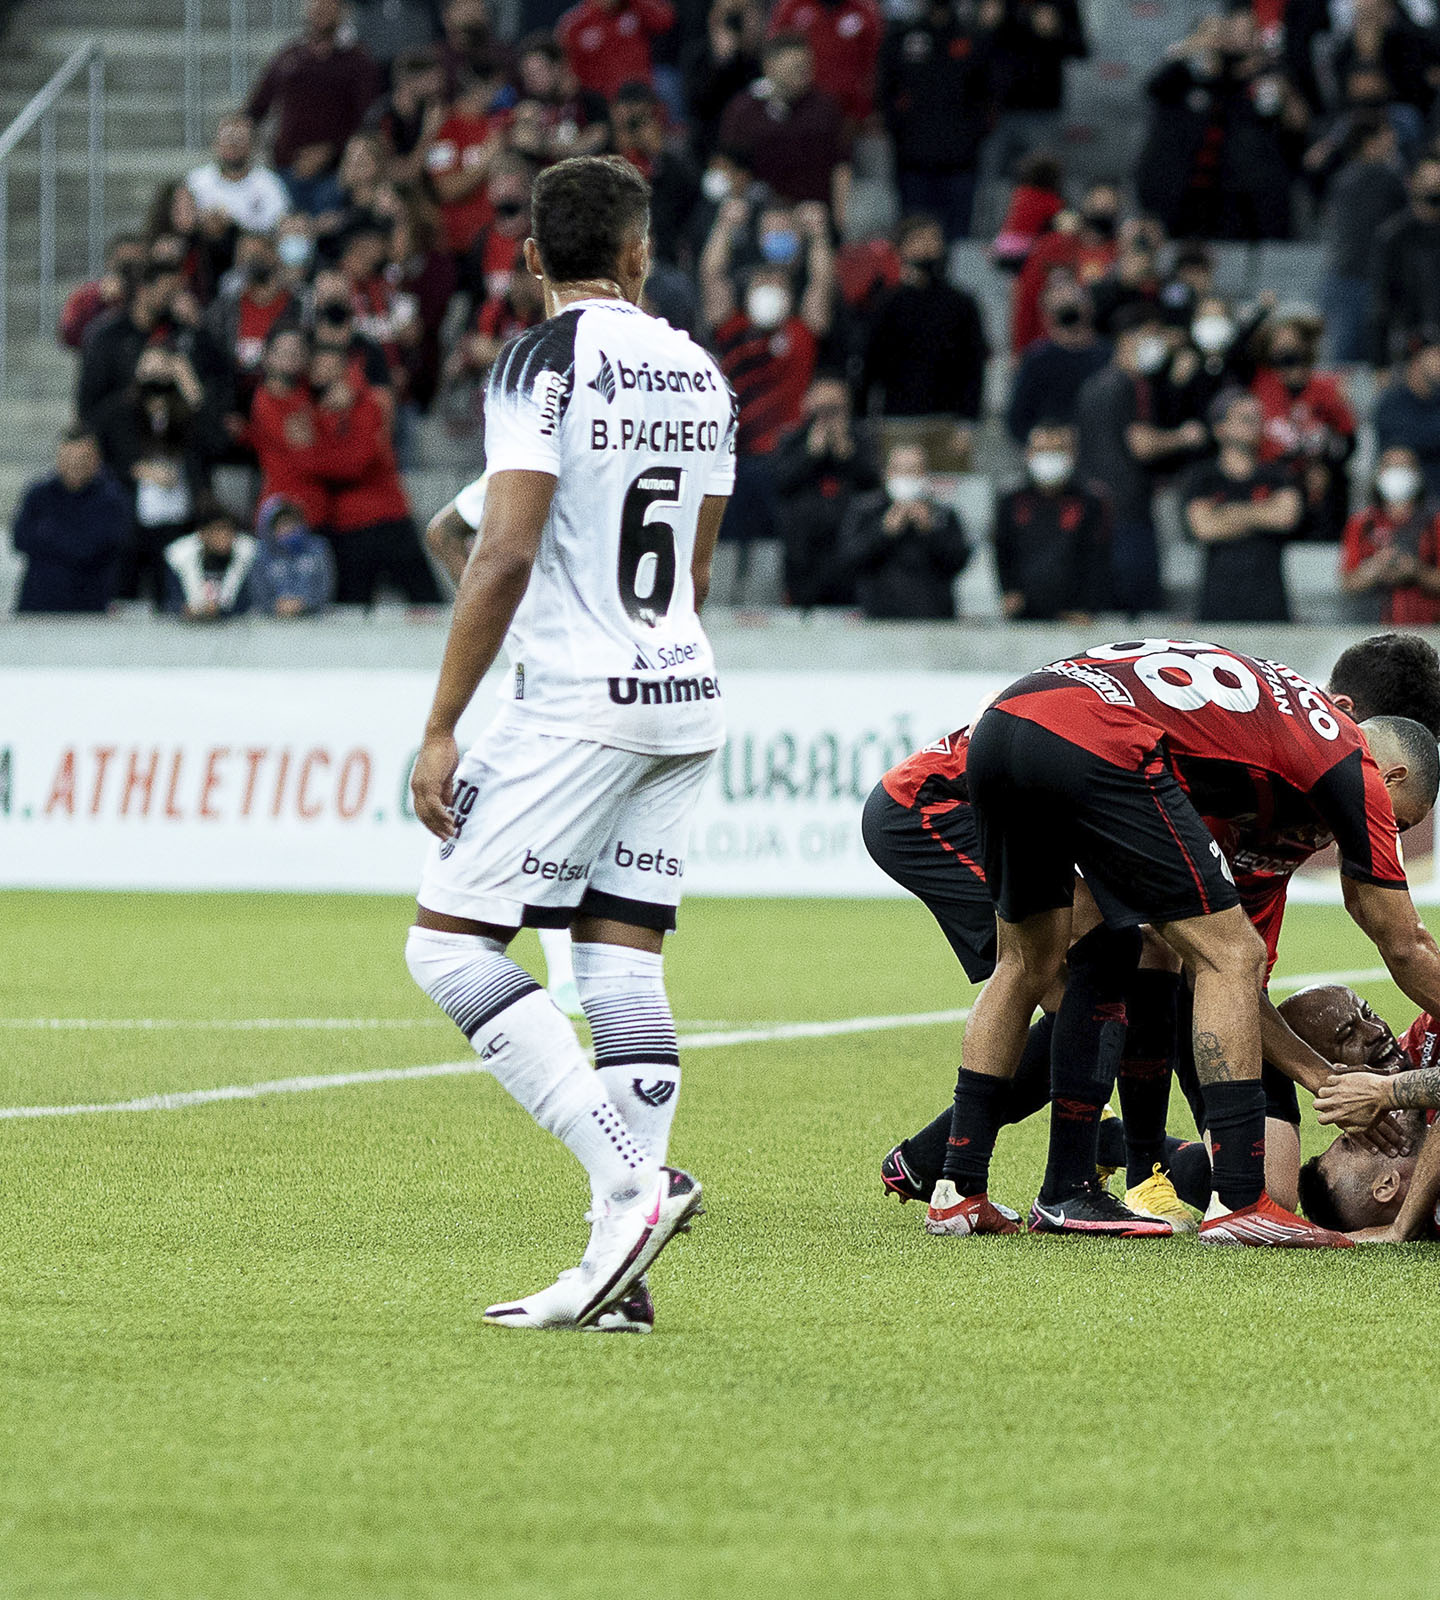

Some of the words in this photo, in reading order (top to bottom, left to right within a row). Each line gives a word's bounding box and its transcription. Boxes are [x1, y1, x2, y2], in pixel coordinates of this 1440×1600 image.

[617, 359, 717, 393] brisanet
[591, 418, 718, 451] B.PACHECO
[617, 466, 688, 618] 6
[657, 642, 699, 669] Sabe
